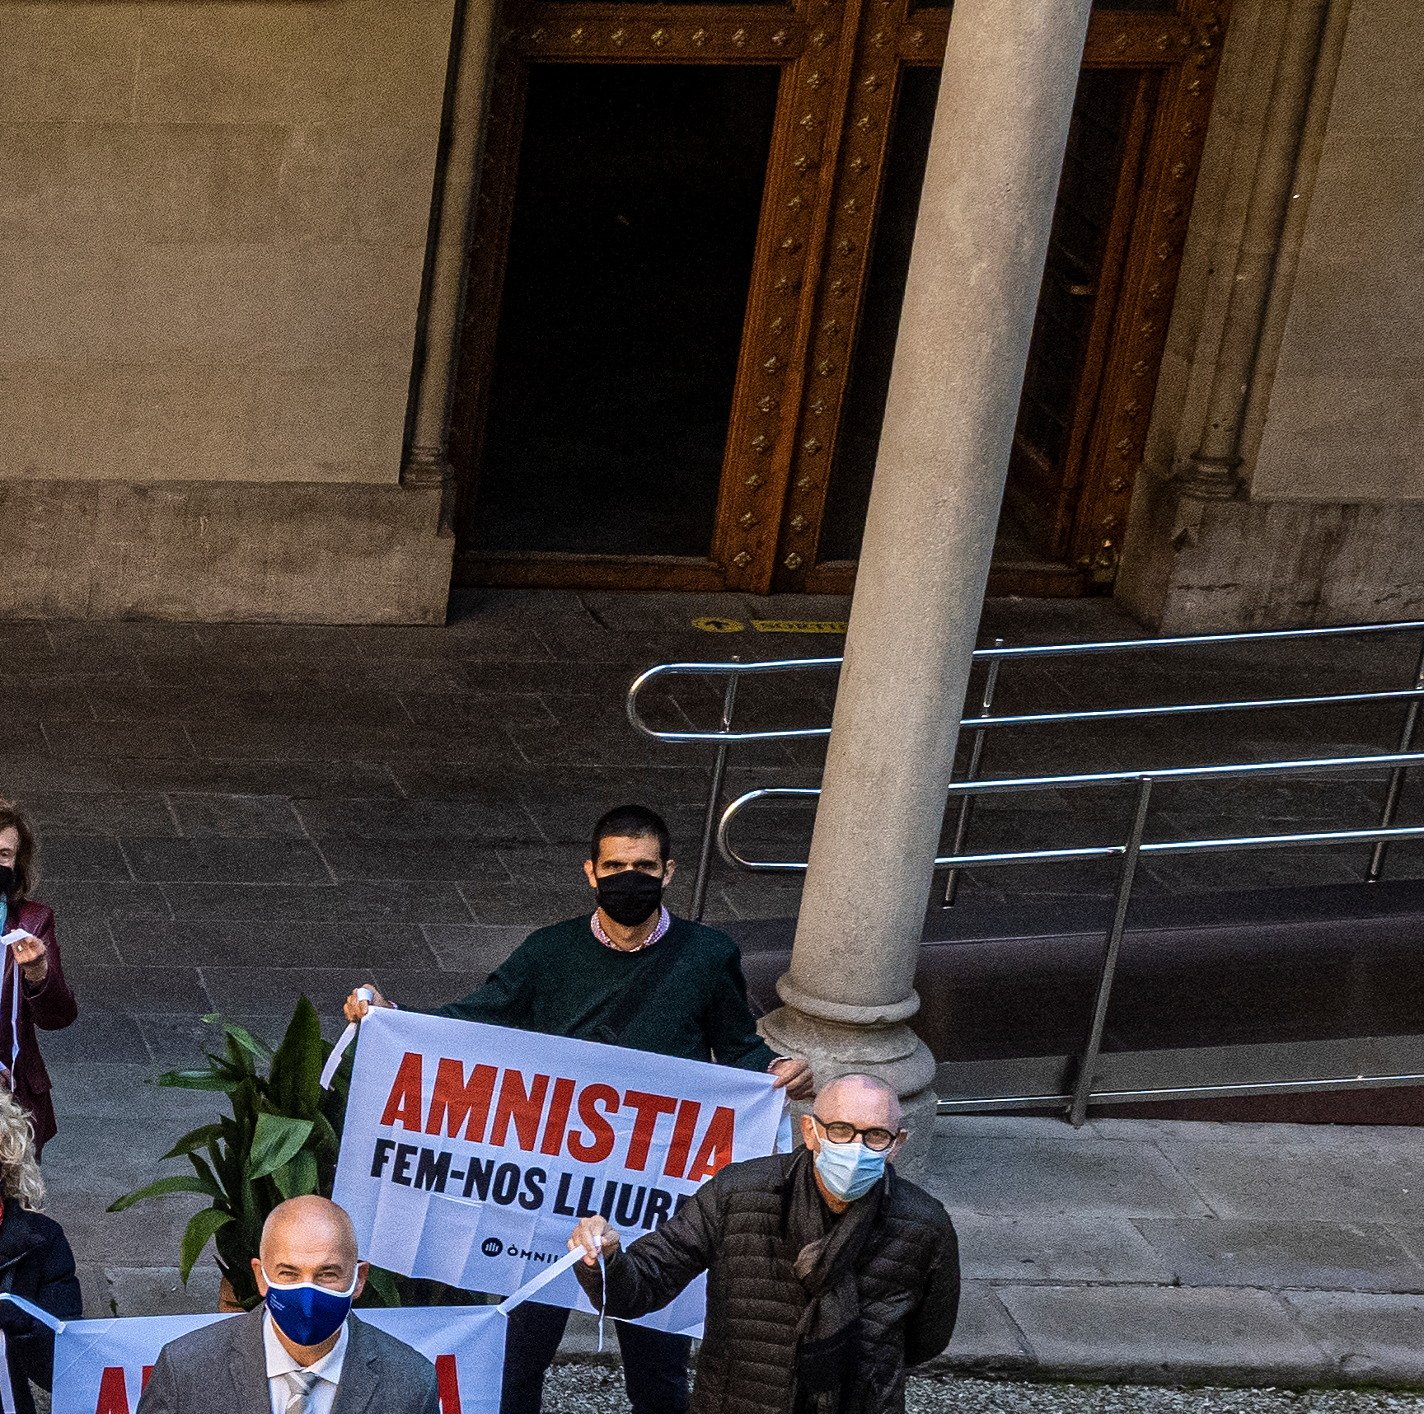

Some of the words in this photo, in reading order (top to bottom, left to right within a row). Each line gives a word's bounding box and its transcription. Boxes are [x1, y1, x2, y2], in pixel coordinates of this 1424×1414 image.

[380, 1052, 735, 1182] AMNISTIA
[370, 1138, 547, 1210] FEM-NOS
[553, 1172, 693, 1230] LLIUR
